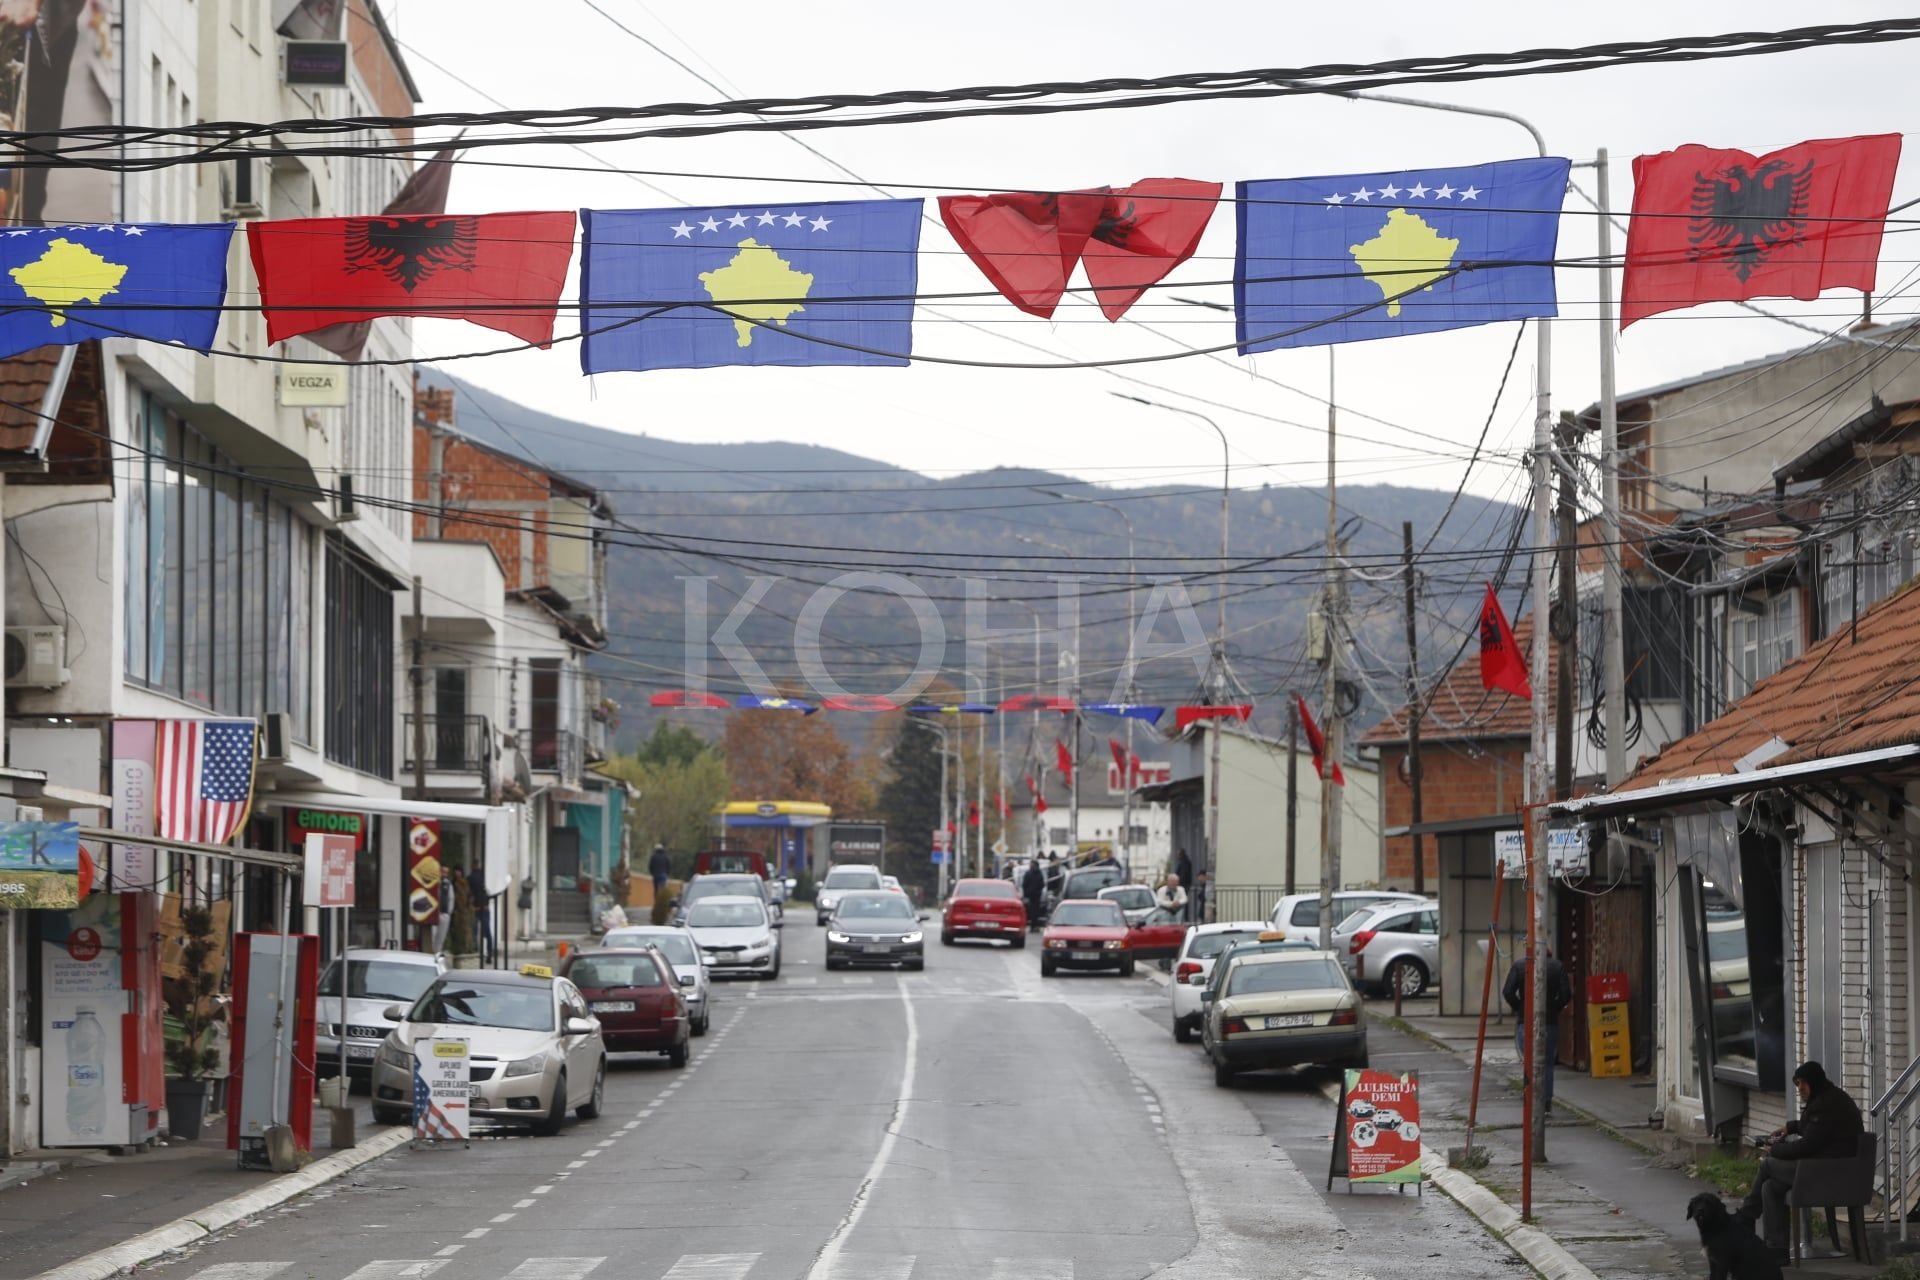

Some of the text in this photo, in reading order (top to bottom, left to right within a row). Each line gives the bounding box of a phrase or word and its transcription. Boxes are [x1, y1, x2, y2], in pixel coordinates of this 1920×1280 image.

[290, 376, 332, 388] VEGZA
[298, 809, 361, 833] emona
[1371, 1092, 1401, 1102] DEMI
